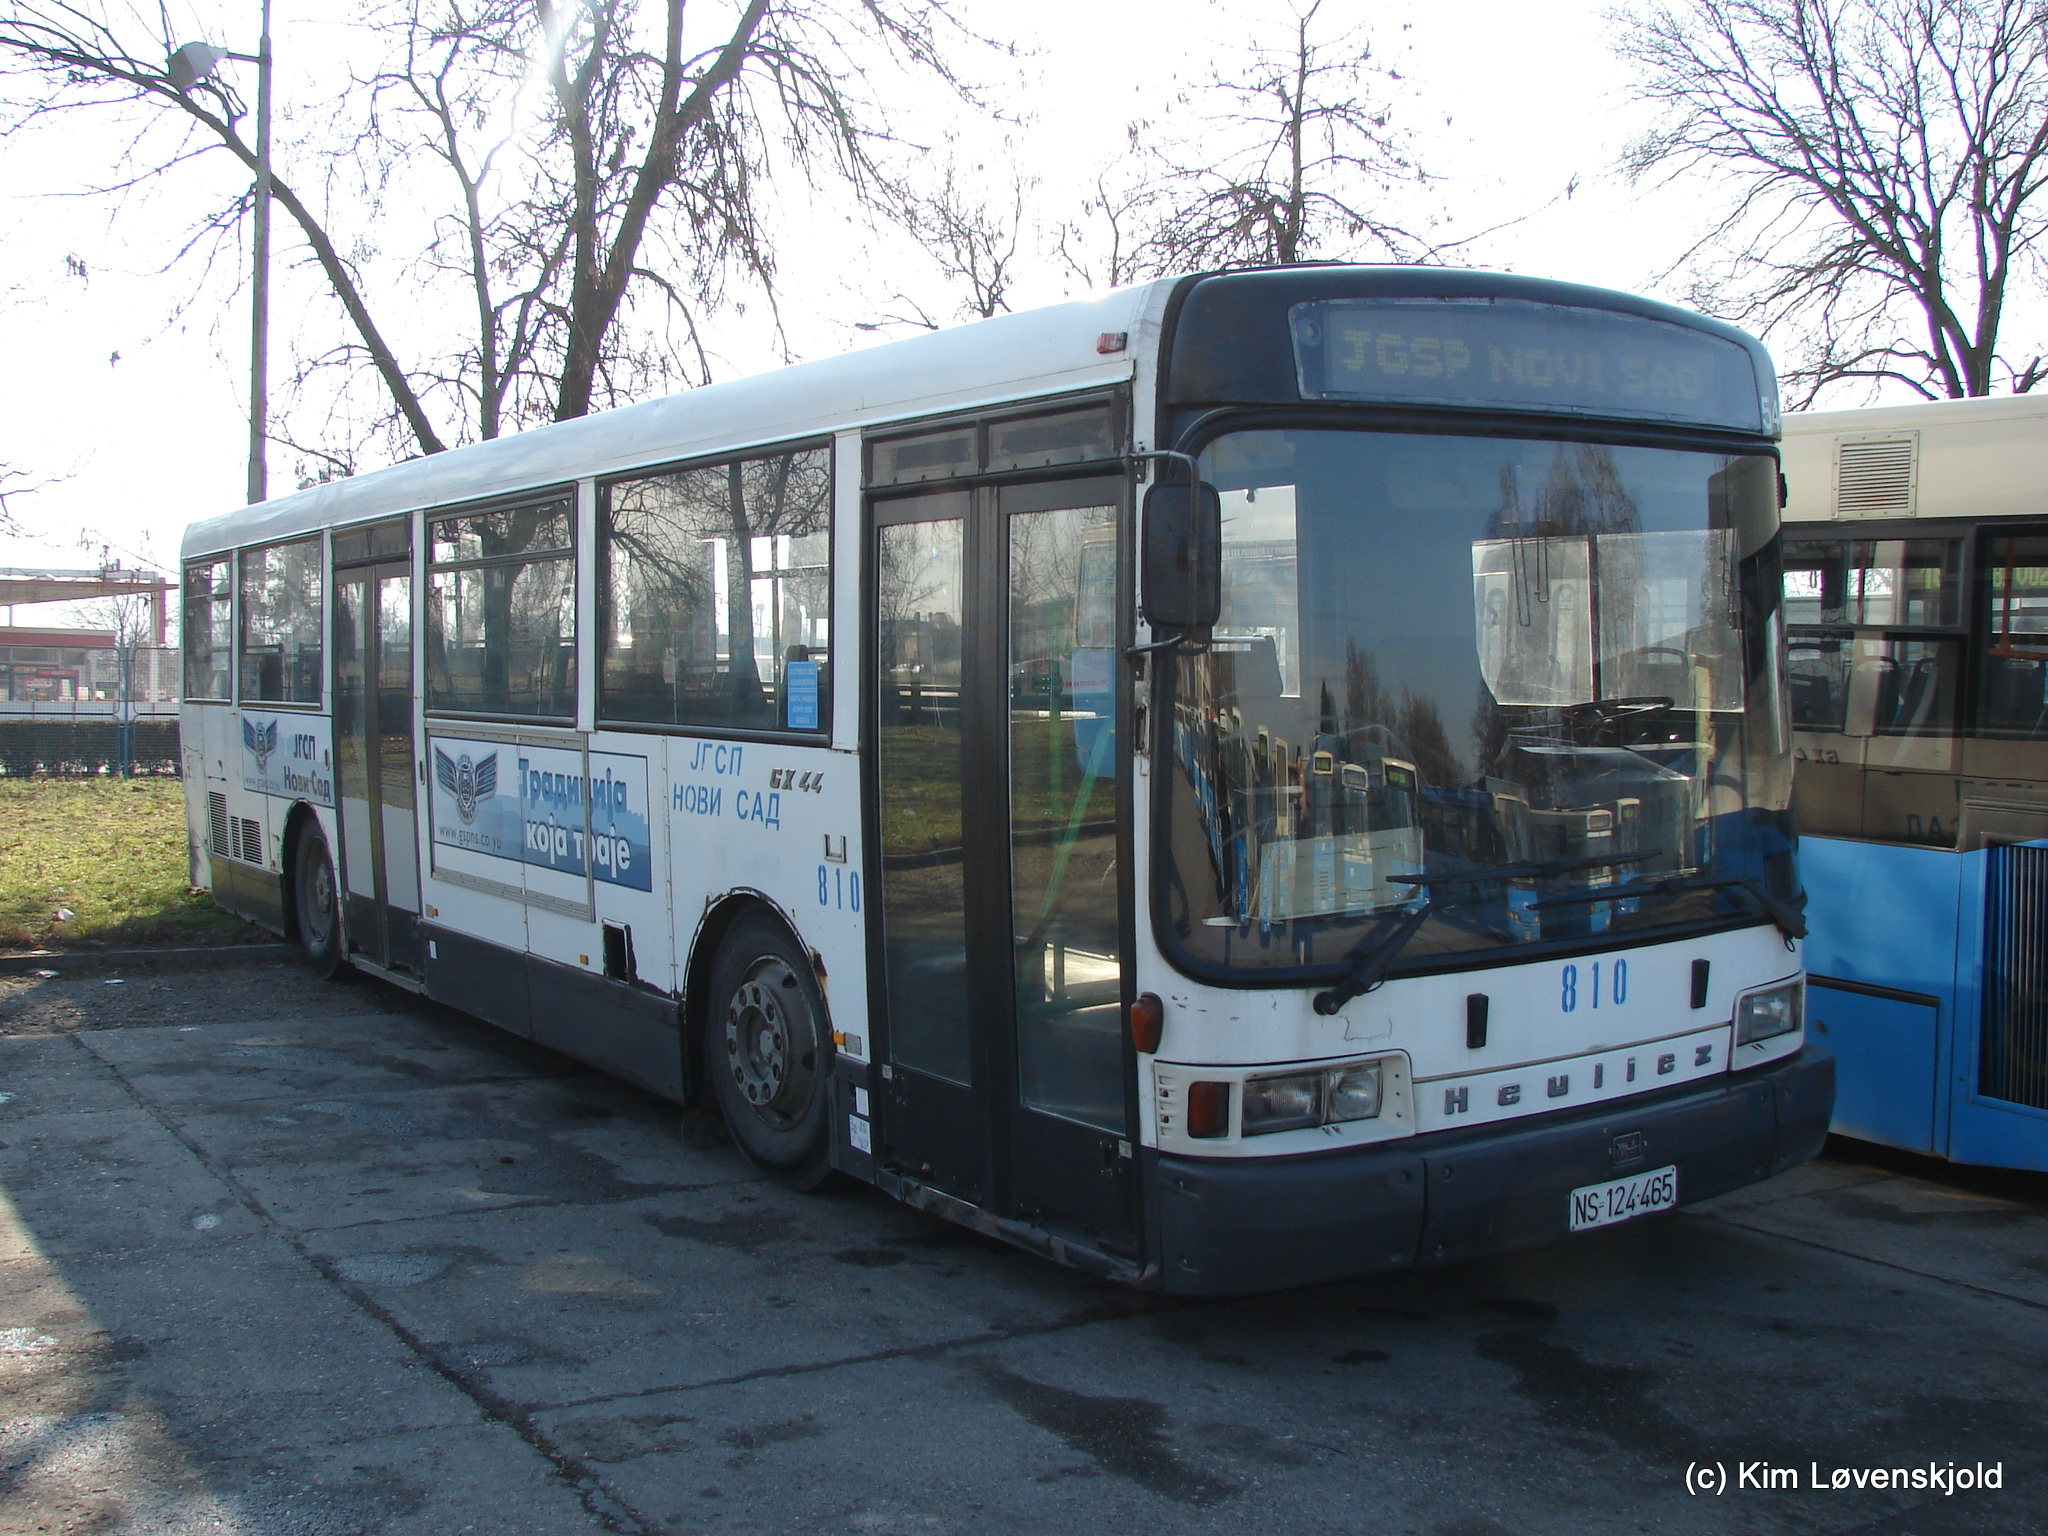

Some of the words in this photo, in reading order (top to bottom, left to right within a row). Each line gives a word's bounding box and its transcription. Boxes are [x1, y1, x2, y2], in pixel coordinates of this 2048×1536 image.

[1343, 329, 1471, 379] JGSP
[1488, 341, 1606, 392] NOVI
[769, 767, 797, 791] GX
[798, 769, 825, 794] 44
[672, 782, 722, 818] НОВИ
[736, 788, 781, 832] САД
[817, 864, 861, 914] 810
[1561, 958, 1628, 1013] 810
